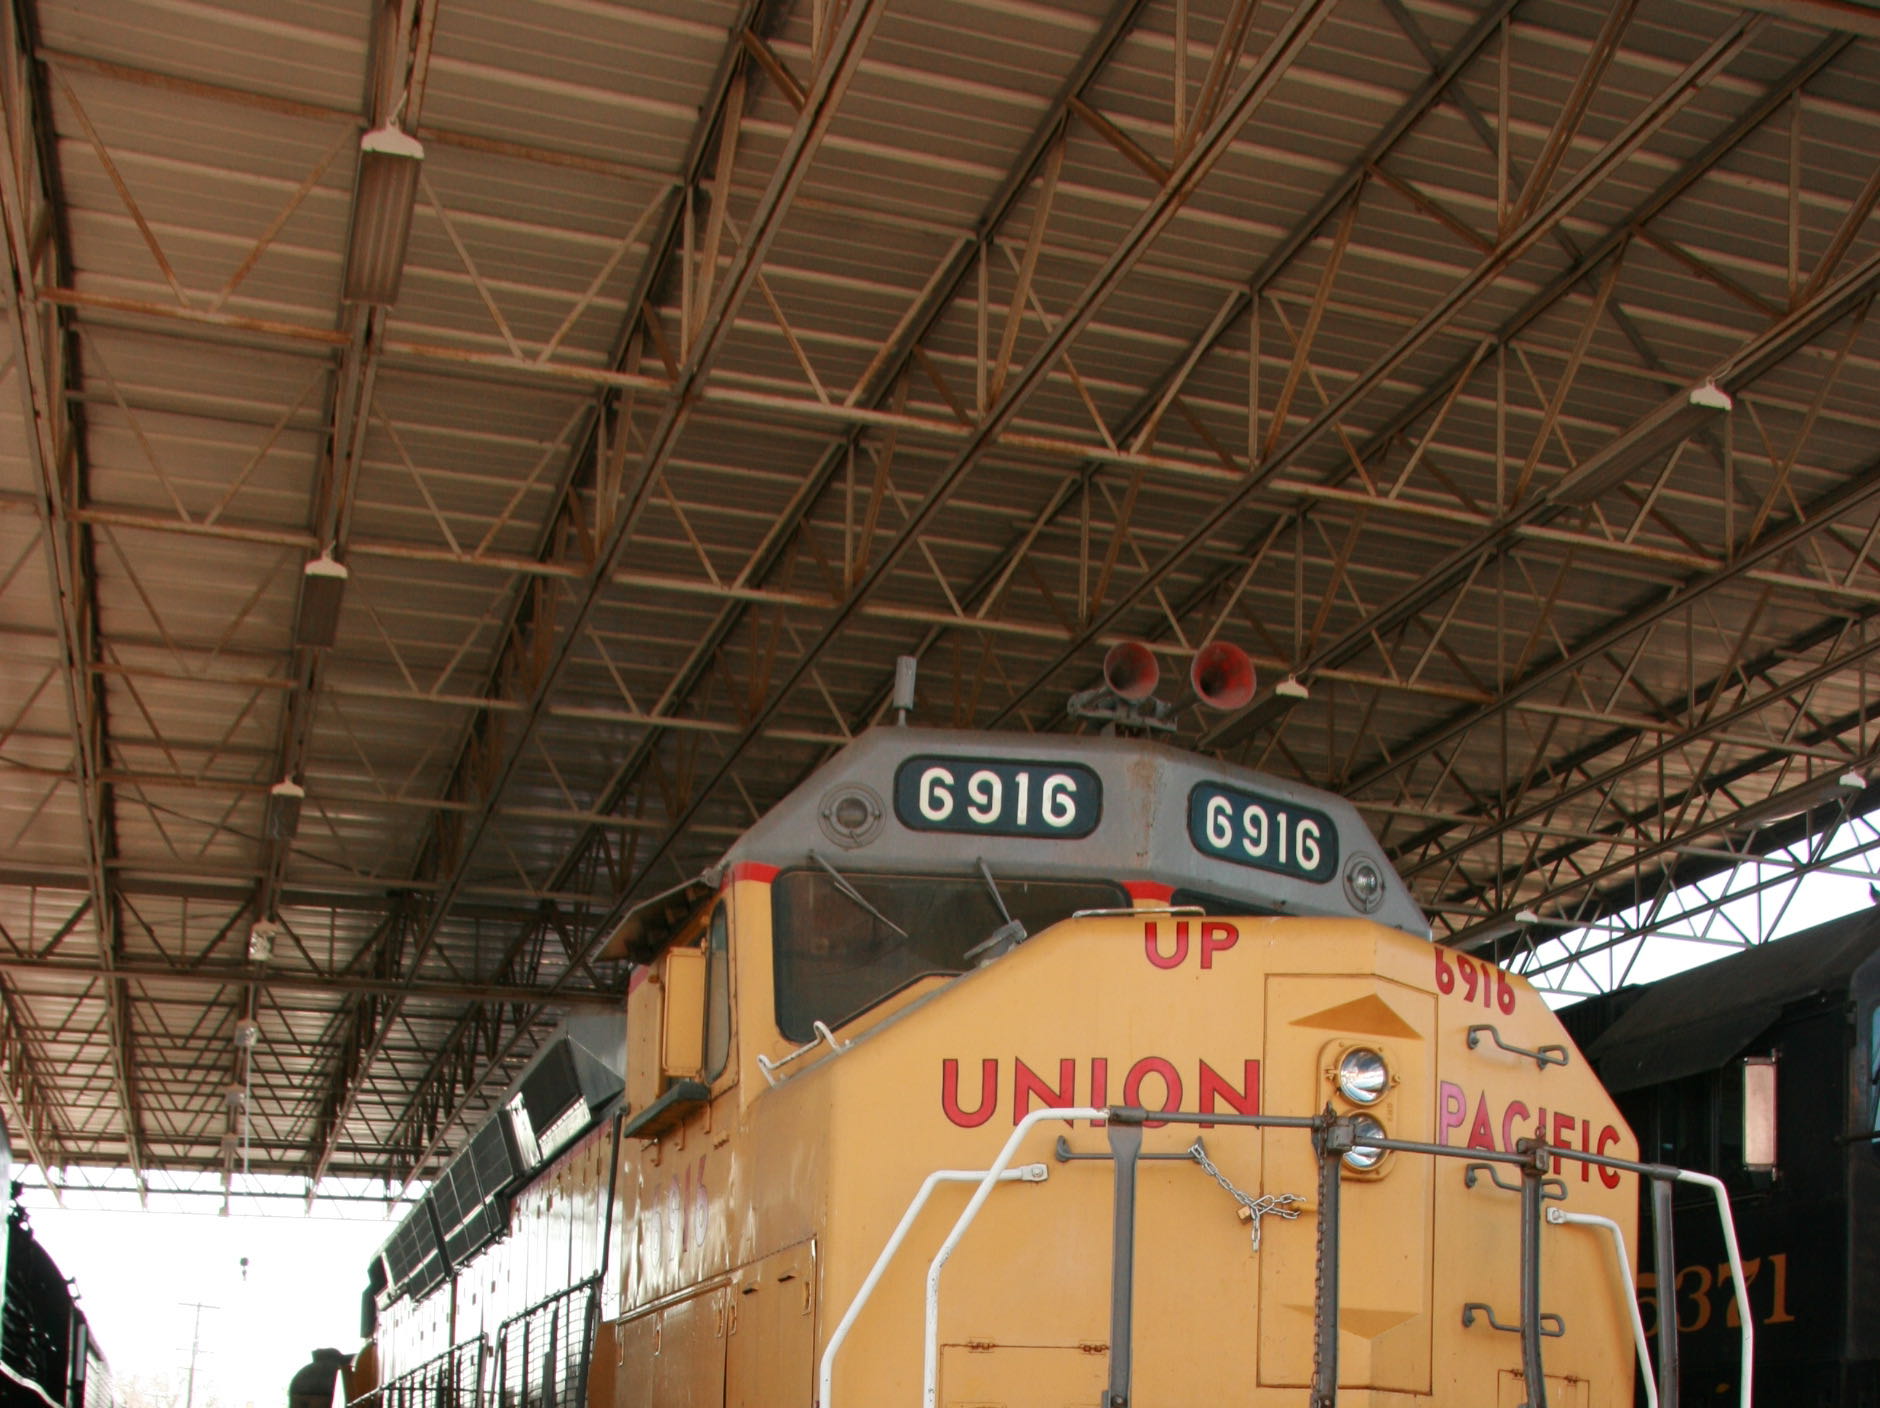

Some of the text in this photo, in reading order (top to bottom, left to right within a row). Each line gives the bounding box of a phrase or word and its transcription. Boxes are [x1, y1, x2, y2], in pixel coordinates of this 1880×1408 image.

[918, 767, 1078, 828] 6916
[1206, 796, 1321, 871] 6916
[1144, 922, 1240, 970] UP
[1434, 946, 1516, 1016] 6916
[941, 1058, 1261, 1129] UNION
[1439, 1080, 1622, 1189] PACIFIC
